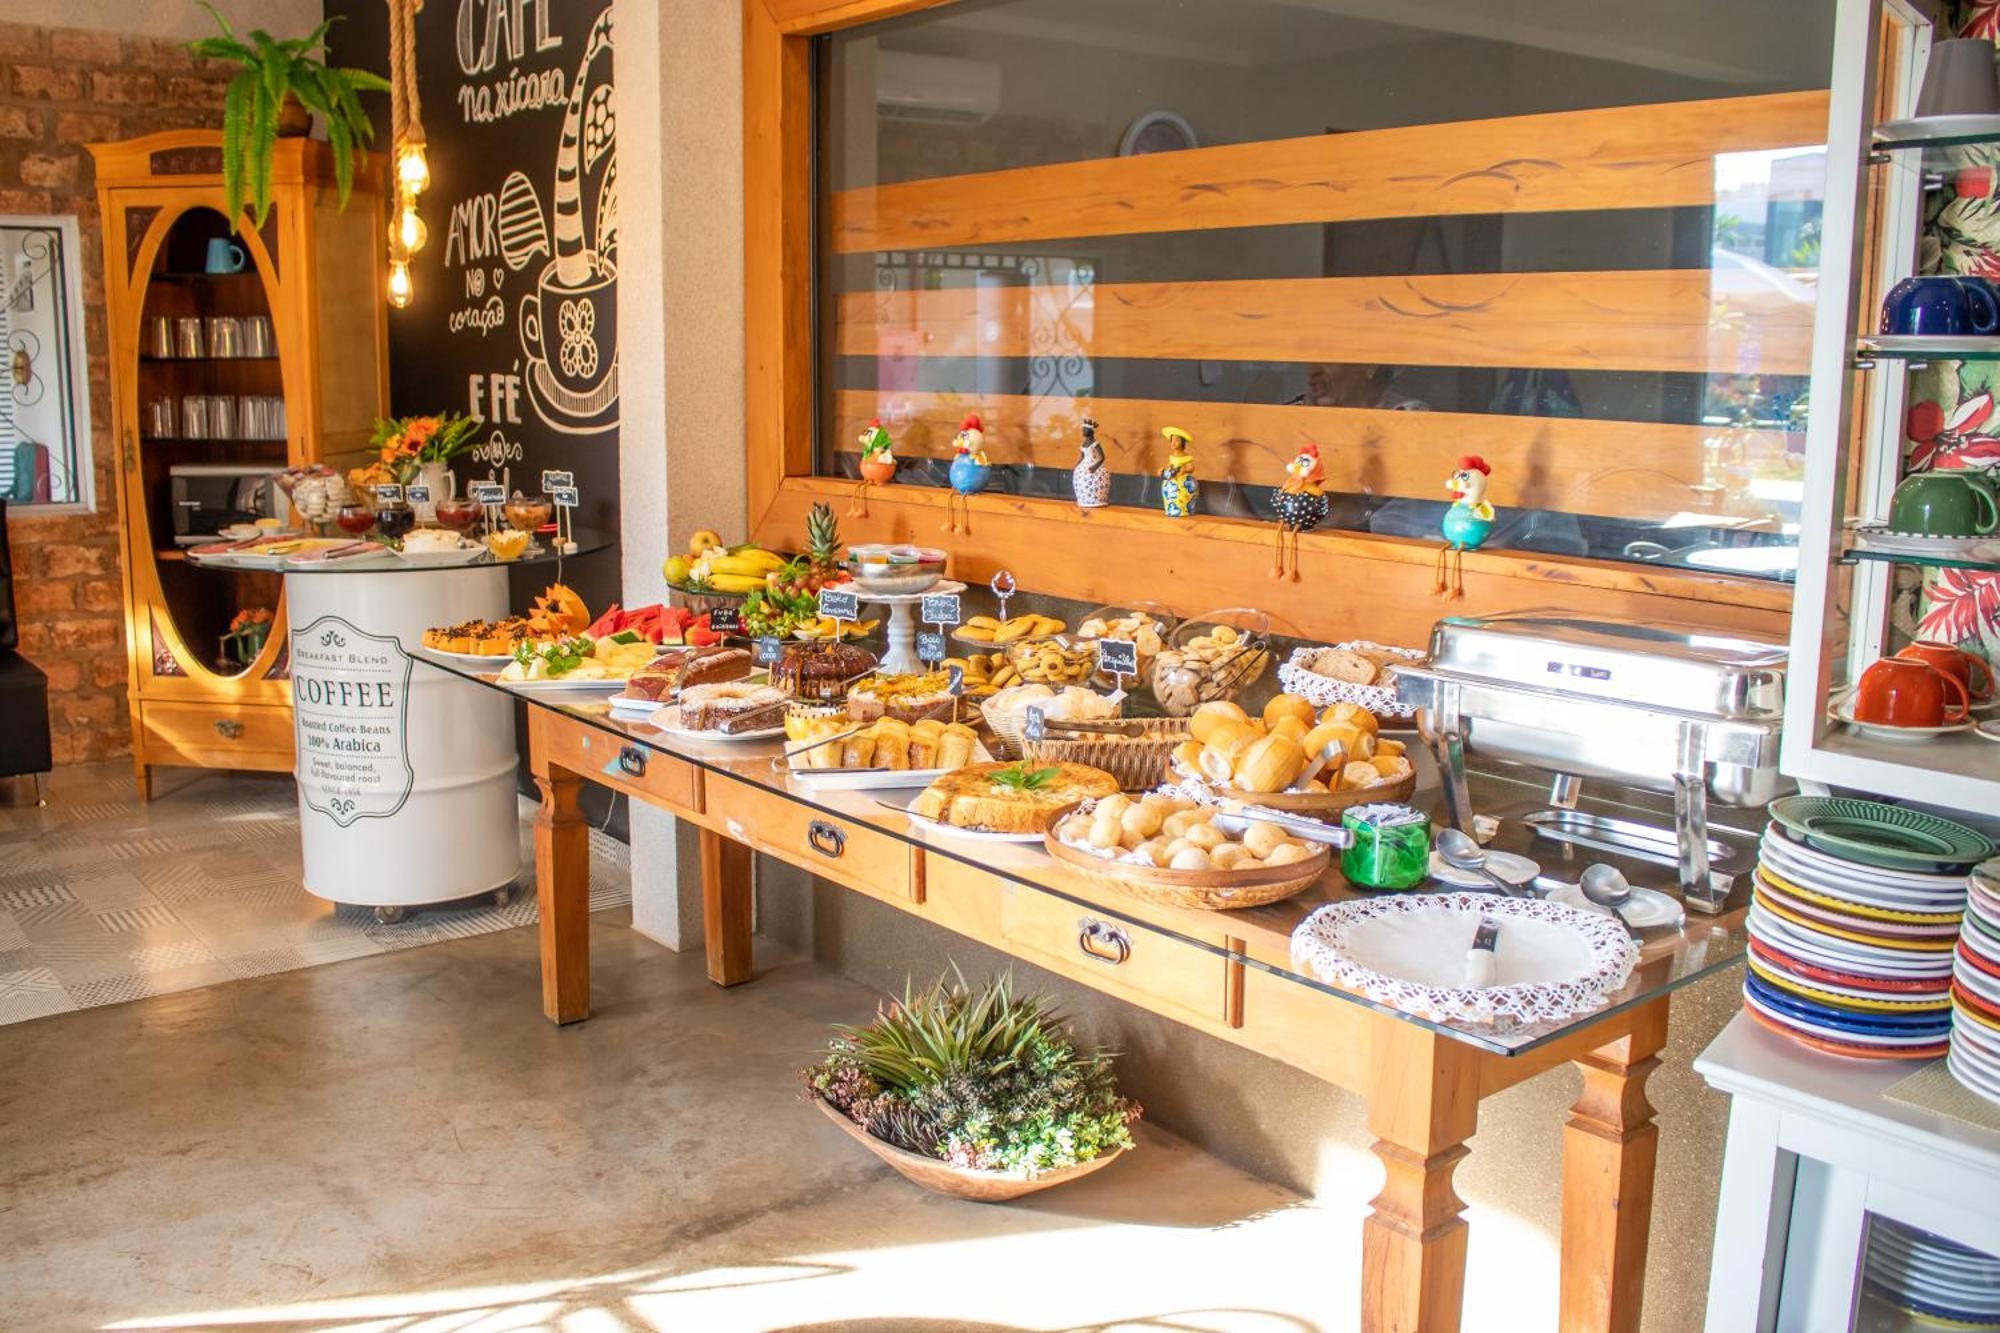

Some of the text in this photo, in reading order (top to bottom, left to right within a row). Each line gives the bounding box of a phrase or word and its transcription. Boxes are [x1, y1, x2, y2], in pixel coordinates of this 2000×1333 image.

[495, 67, 569, 117] xícara
[445, 193, 498, 267] AMOR
[449, 296, 505, 337] coração
[469, 358, 522, 425] E FÉ
[296, 648, 388, 665] BREAKFAST BLEND
[296, 674, 394, 708] COFFEE
[332, 737, 382, 753] Arabica
[359, 724, 391, 735] Beans
